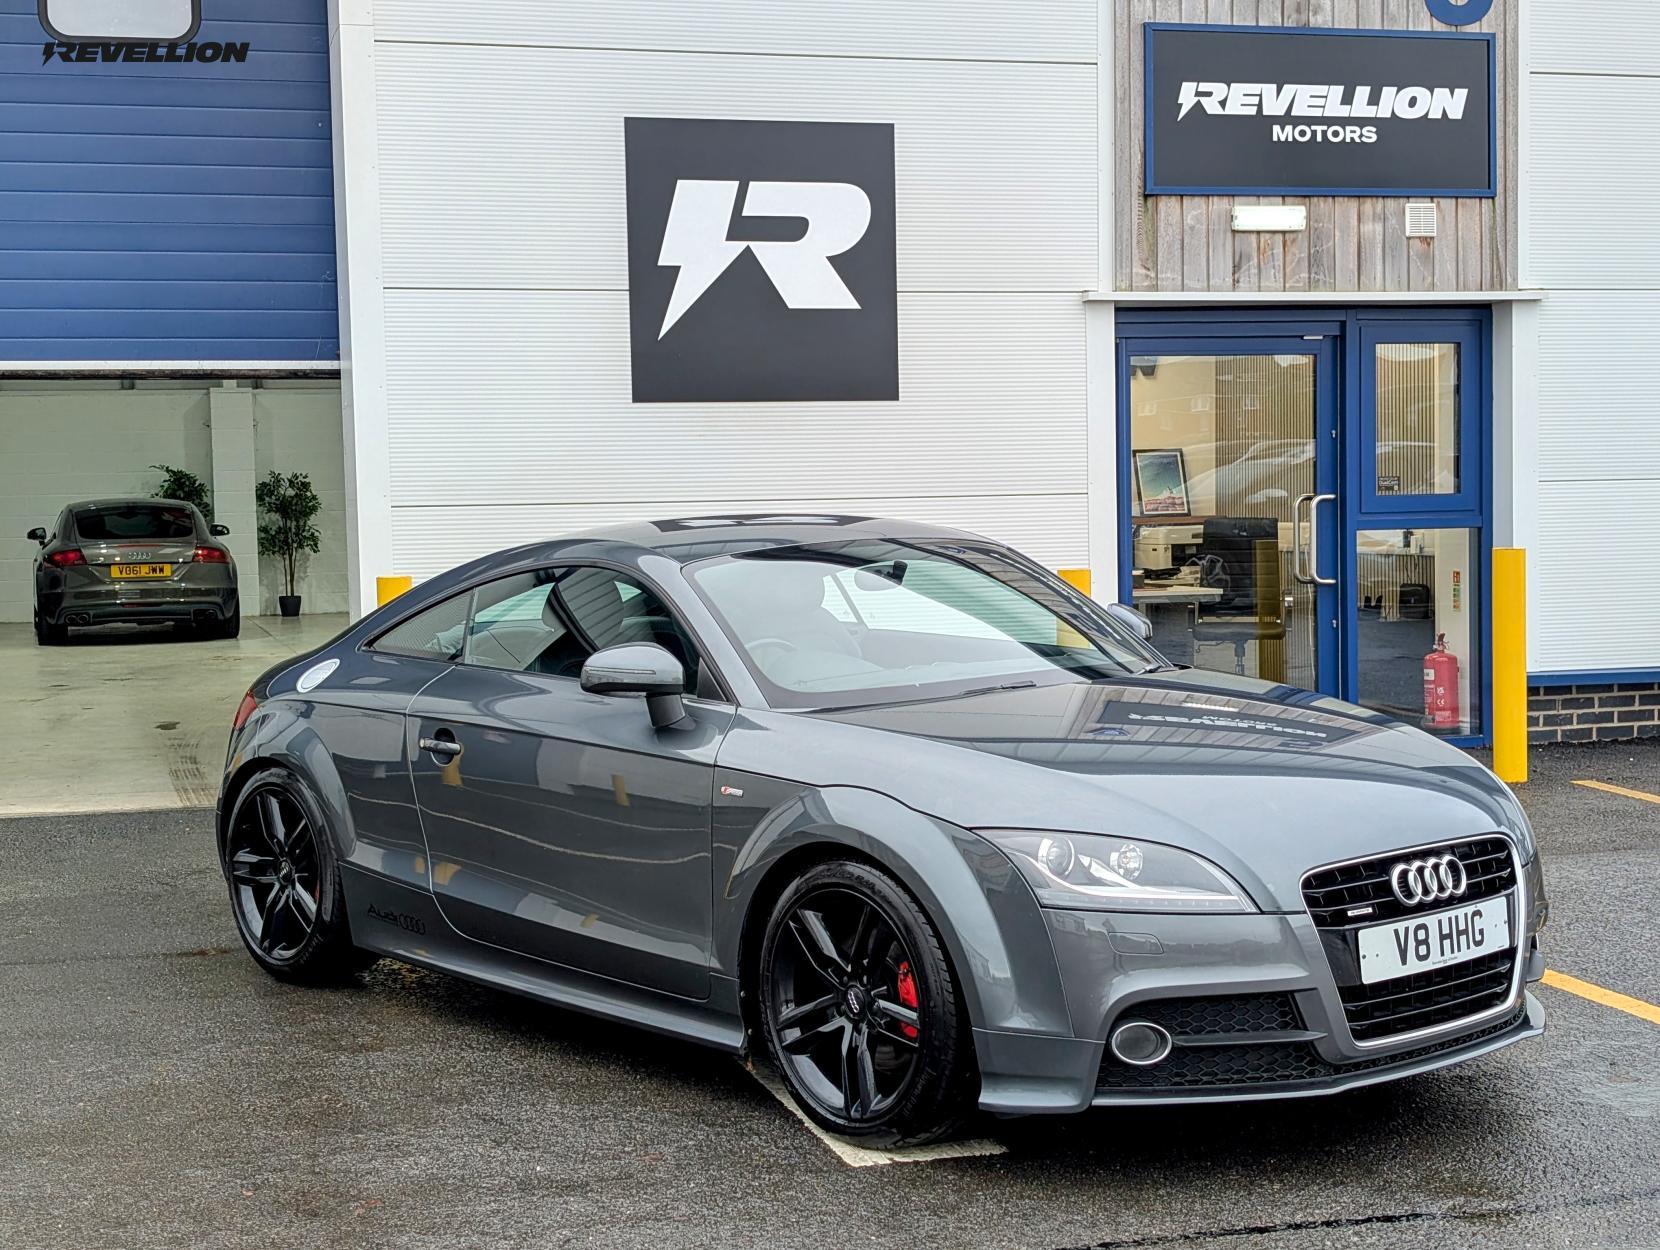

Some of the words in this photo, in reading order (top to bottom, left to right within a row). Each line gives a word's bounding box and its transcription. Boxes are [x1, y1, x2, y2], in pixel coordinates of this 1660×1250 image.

[1177, 82, 1468, 121] REVELLION
[1272, 125, 1378, 143] MOTORS
[145, 565, 165, 575] JWW
[1393, 922, 1431, 966] V8
[1437, 909, 1485, 957] HHG
